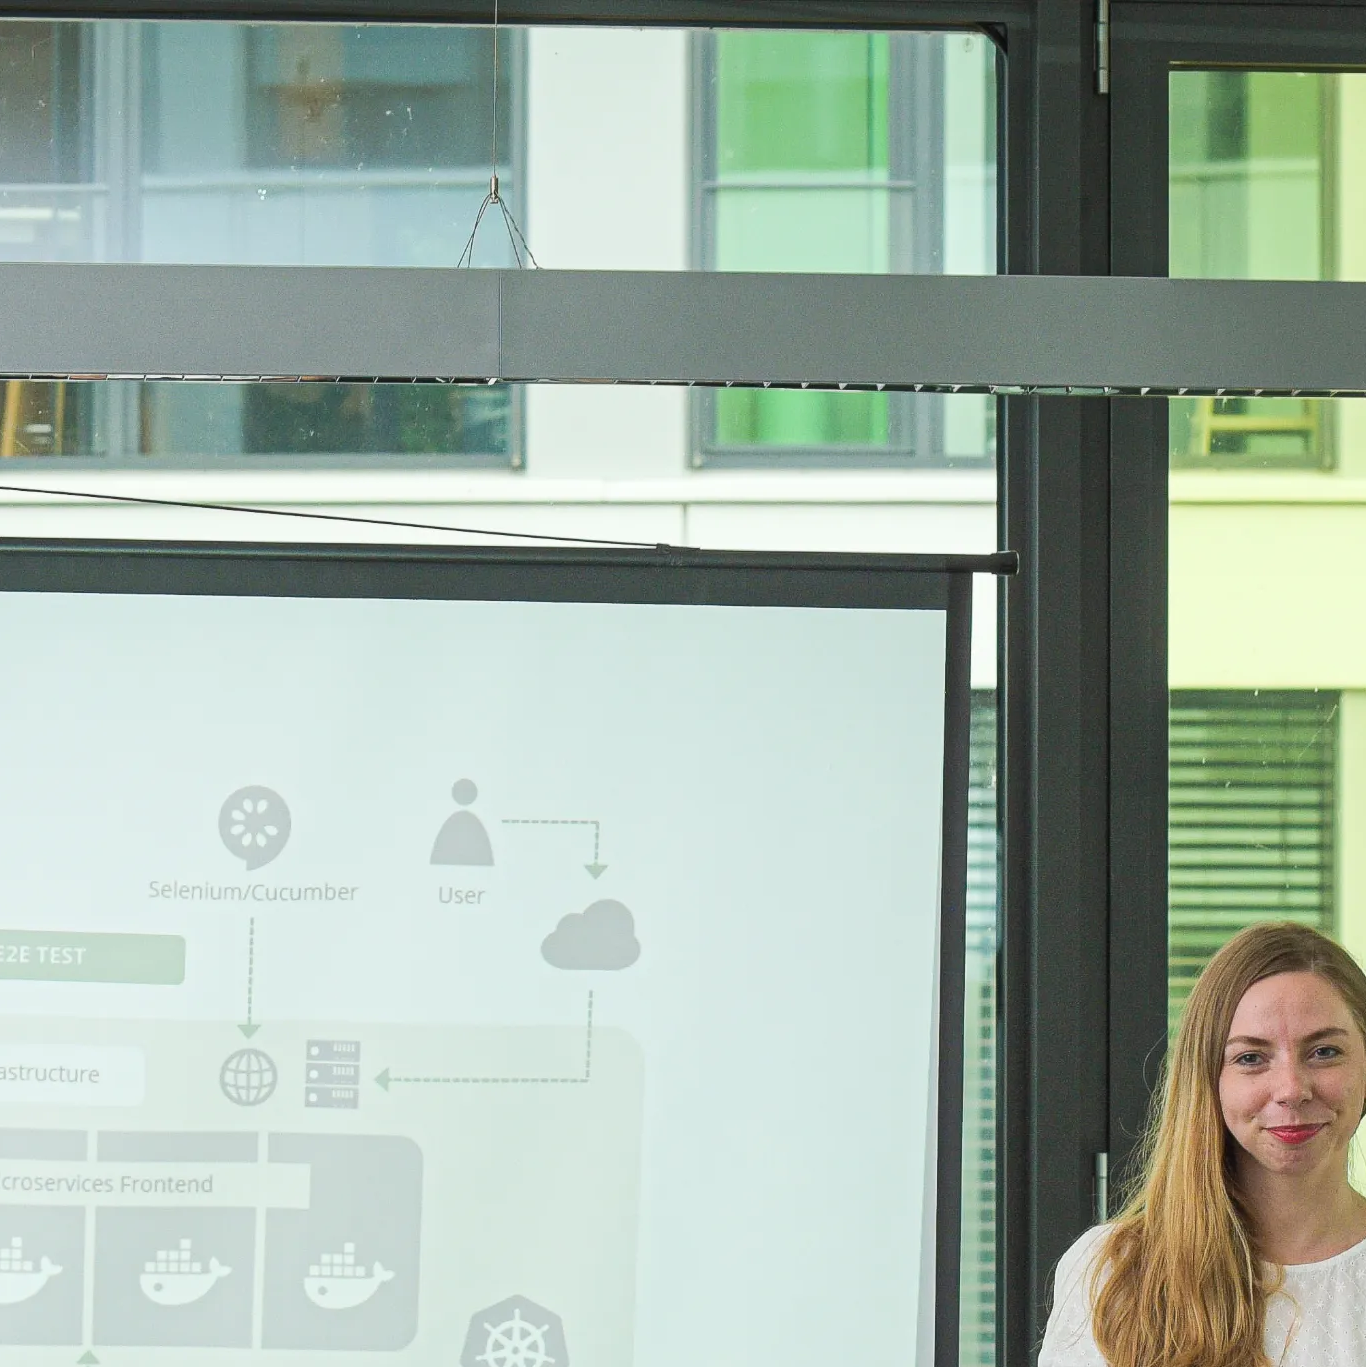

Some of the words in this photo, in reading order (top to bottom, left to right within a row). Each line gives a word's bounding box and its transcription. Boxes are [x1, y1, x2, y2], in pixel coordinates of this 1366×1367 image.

[150, 881, 358, 901] Selenium/Cucumber
[439, 887, 485, 904] User
[37, 947, 86, 964] TEST
[121, 1175, 213, 1193] Frontend
